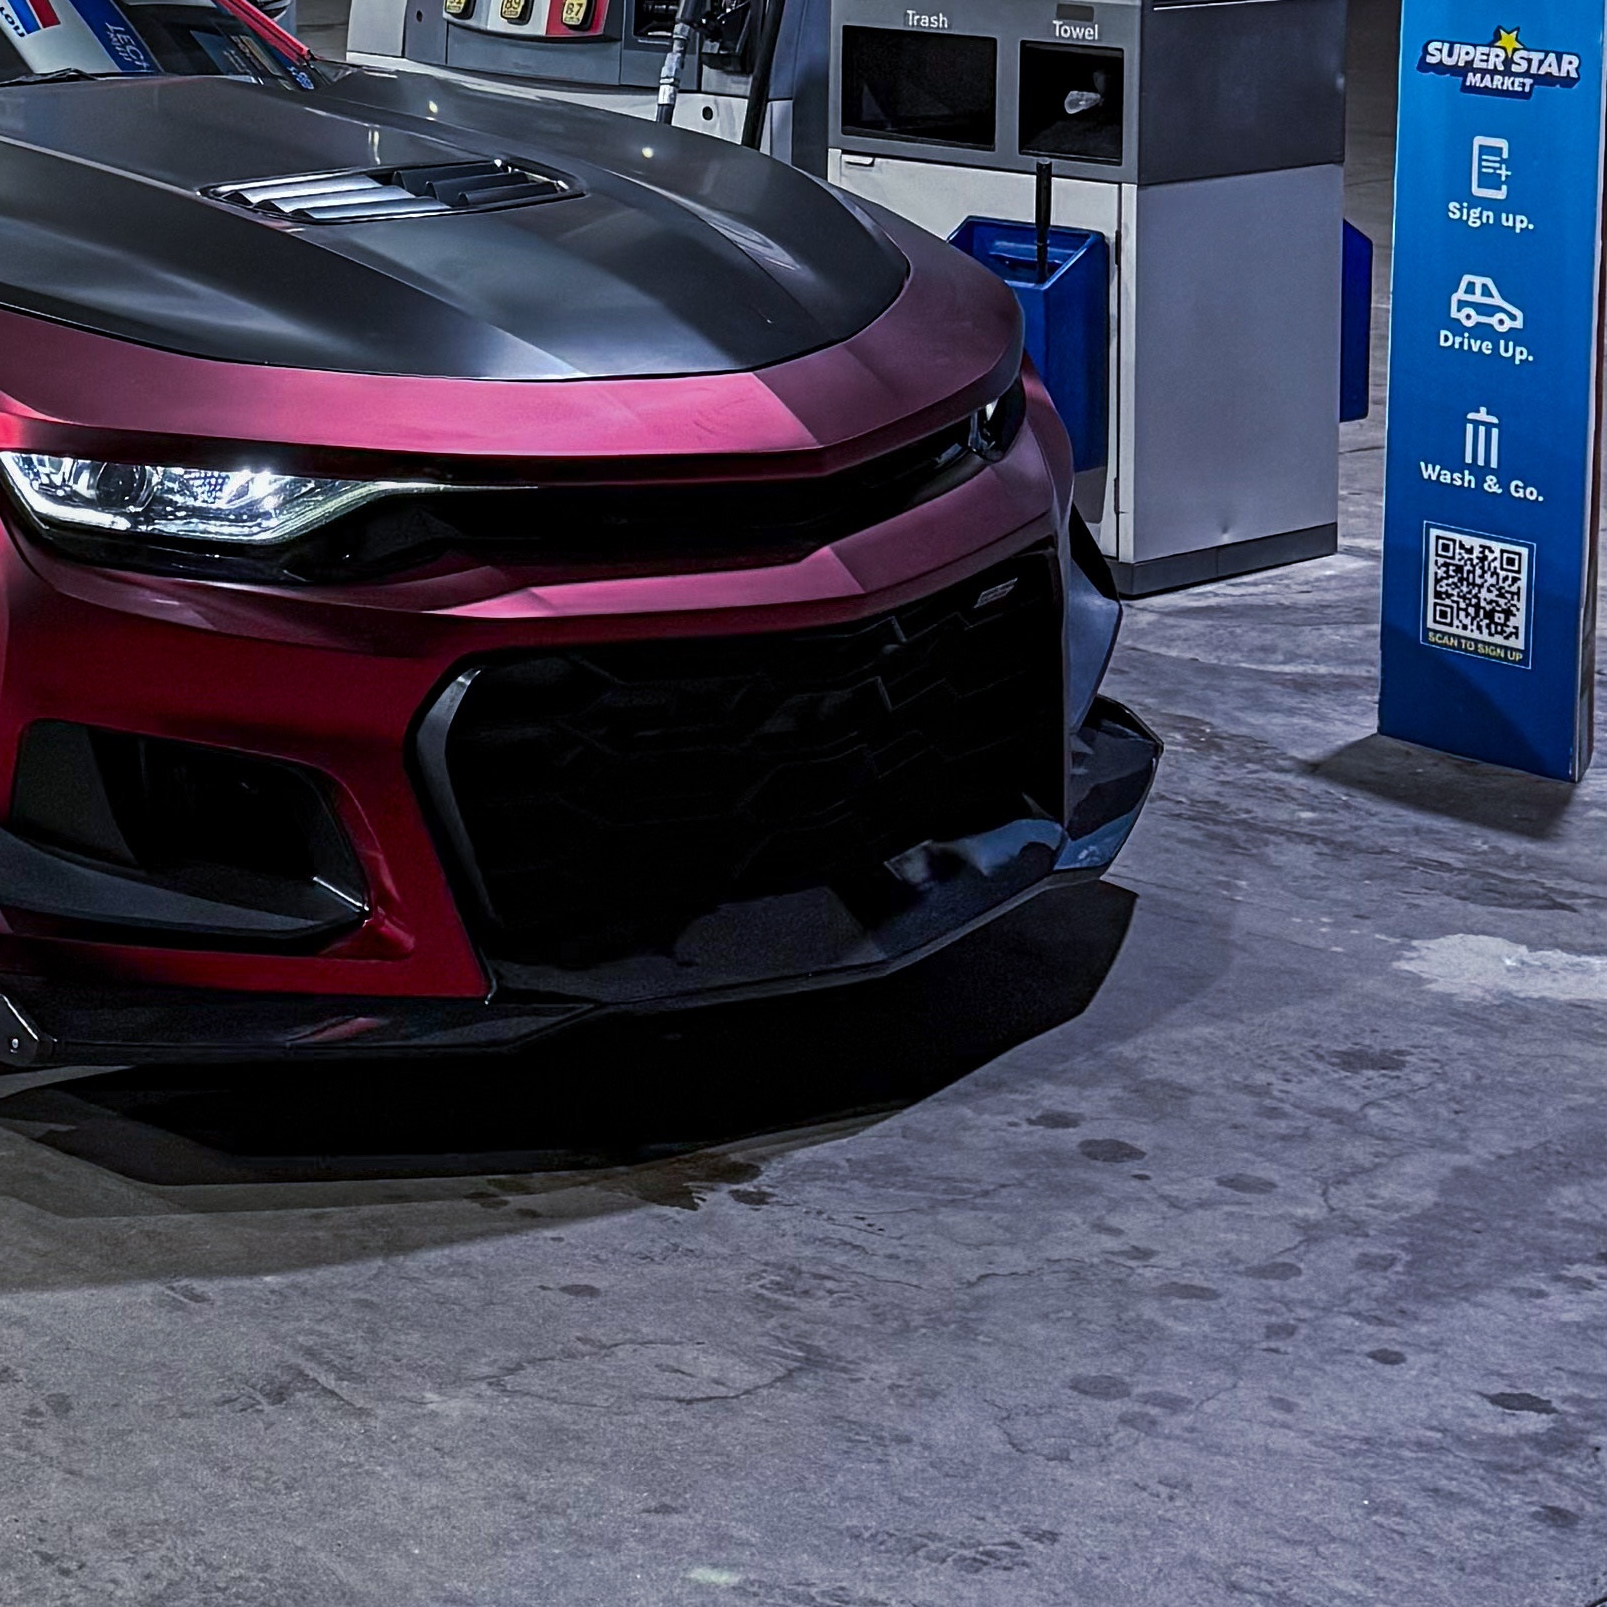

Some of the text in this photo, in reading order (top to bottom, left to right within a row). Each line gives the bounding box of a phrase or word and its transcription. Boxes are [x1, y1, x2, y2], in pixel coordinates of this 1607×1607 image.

[566, 2, 583, 16] 87
[906, 10, 948, 28] Trash
[1052, 20, 1098, 40] Towel
[1426, 41, 1579, 78] SUPER STAR
[1465, 72, 1533, 93] MARKET
[1448, 202, 1534, 233] Sign up.
[1440, 330, 1534, 365] Drive Up.
[1420, 461, 1544, 502] Wash & Go.
[1428, 632, 1523, 661] SCAN TO SIGN UP
